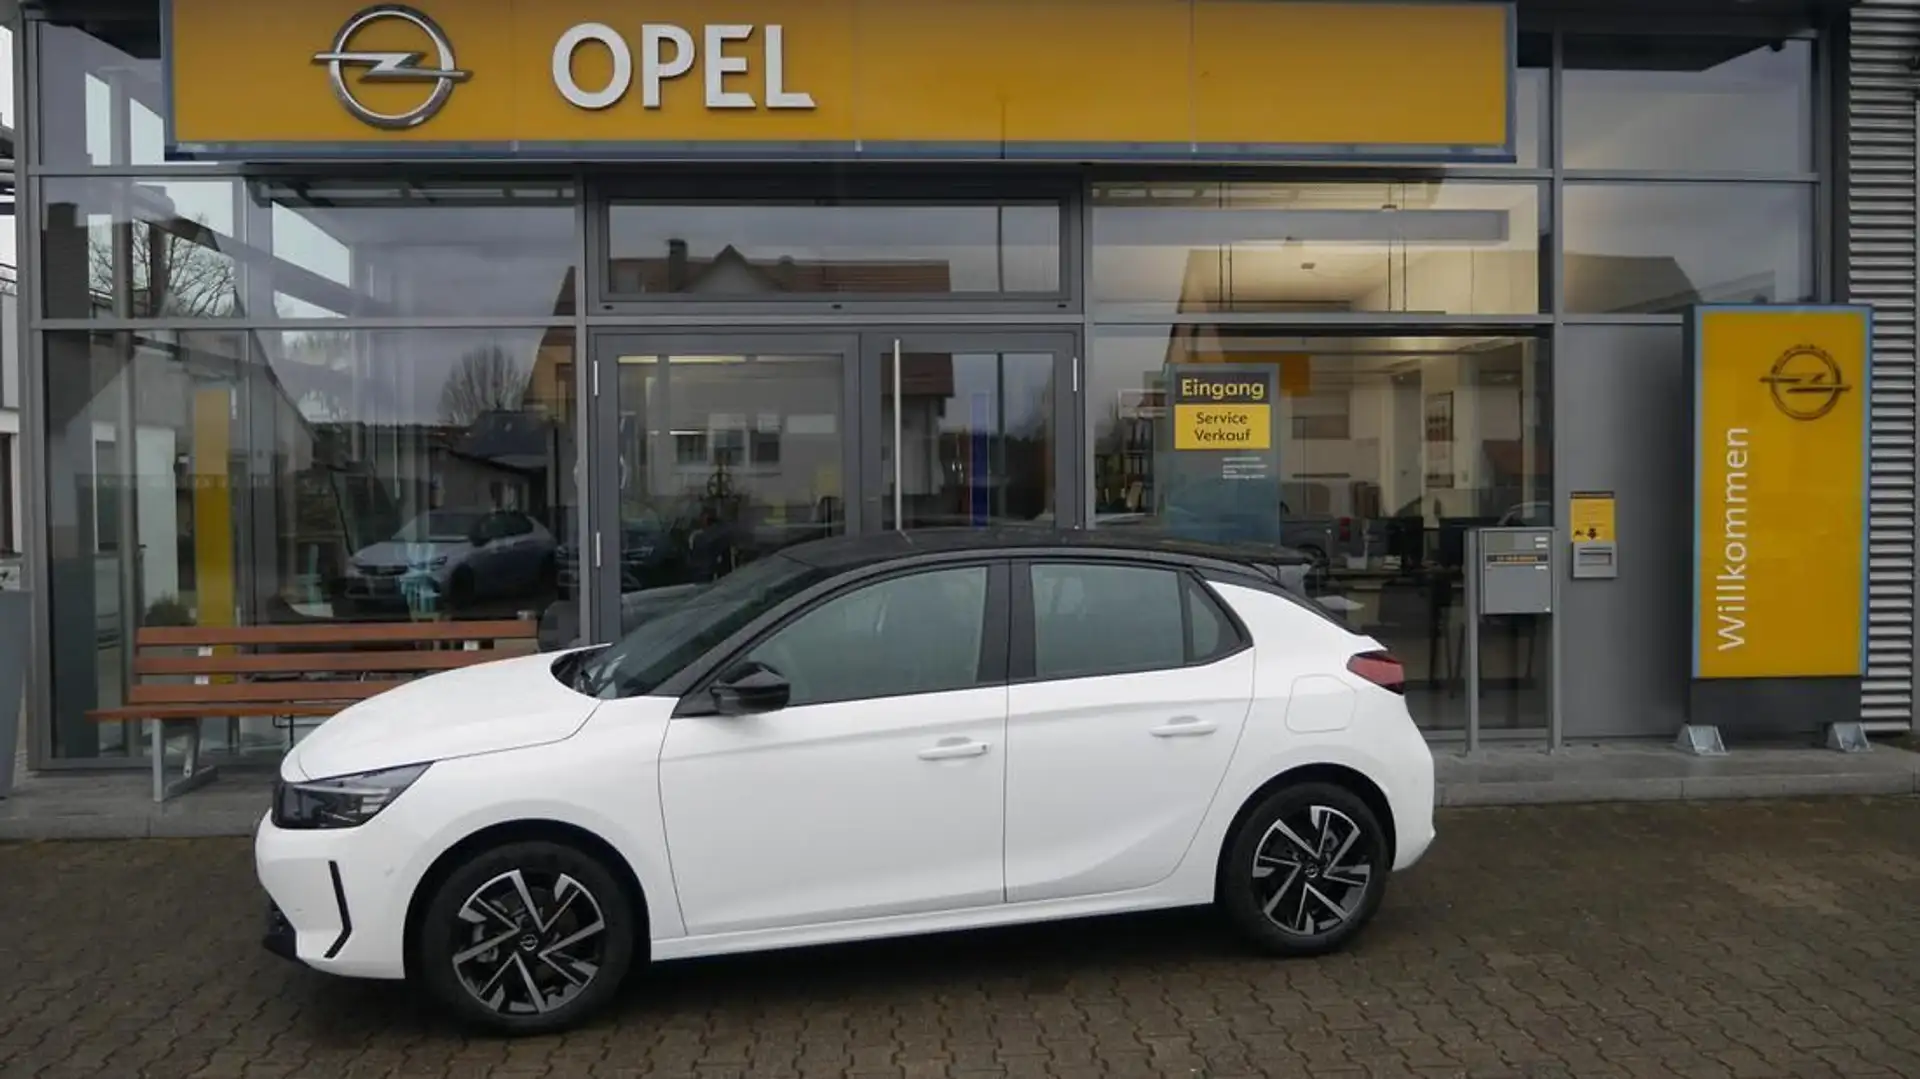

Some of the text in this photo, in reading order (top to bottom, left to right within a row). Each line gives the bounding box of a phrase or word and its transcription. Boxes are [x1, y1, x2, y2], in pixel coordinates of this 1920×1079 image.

[552, 22, 816, 109] OPEL
[1181, 378, 1264, 400] Eingang
[1196, 411, 1248, 425] Service
[1194, 428, 1251, 441] Verkauf
[1716, 427, 1748, 650] Willkommen
